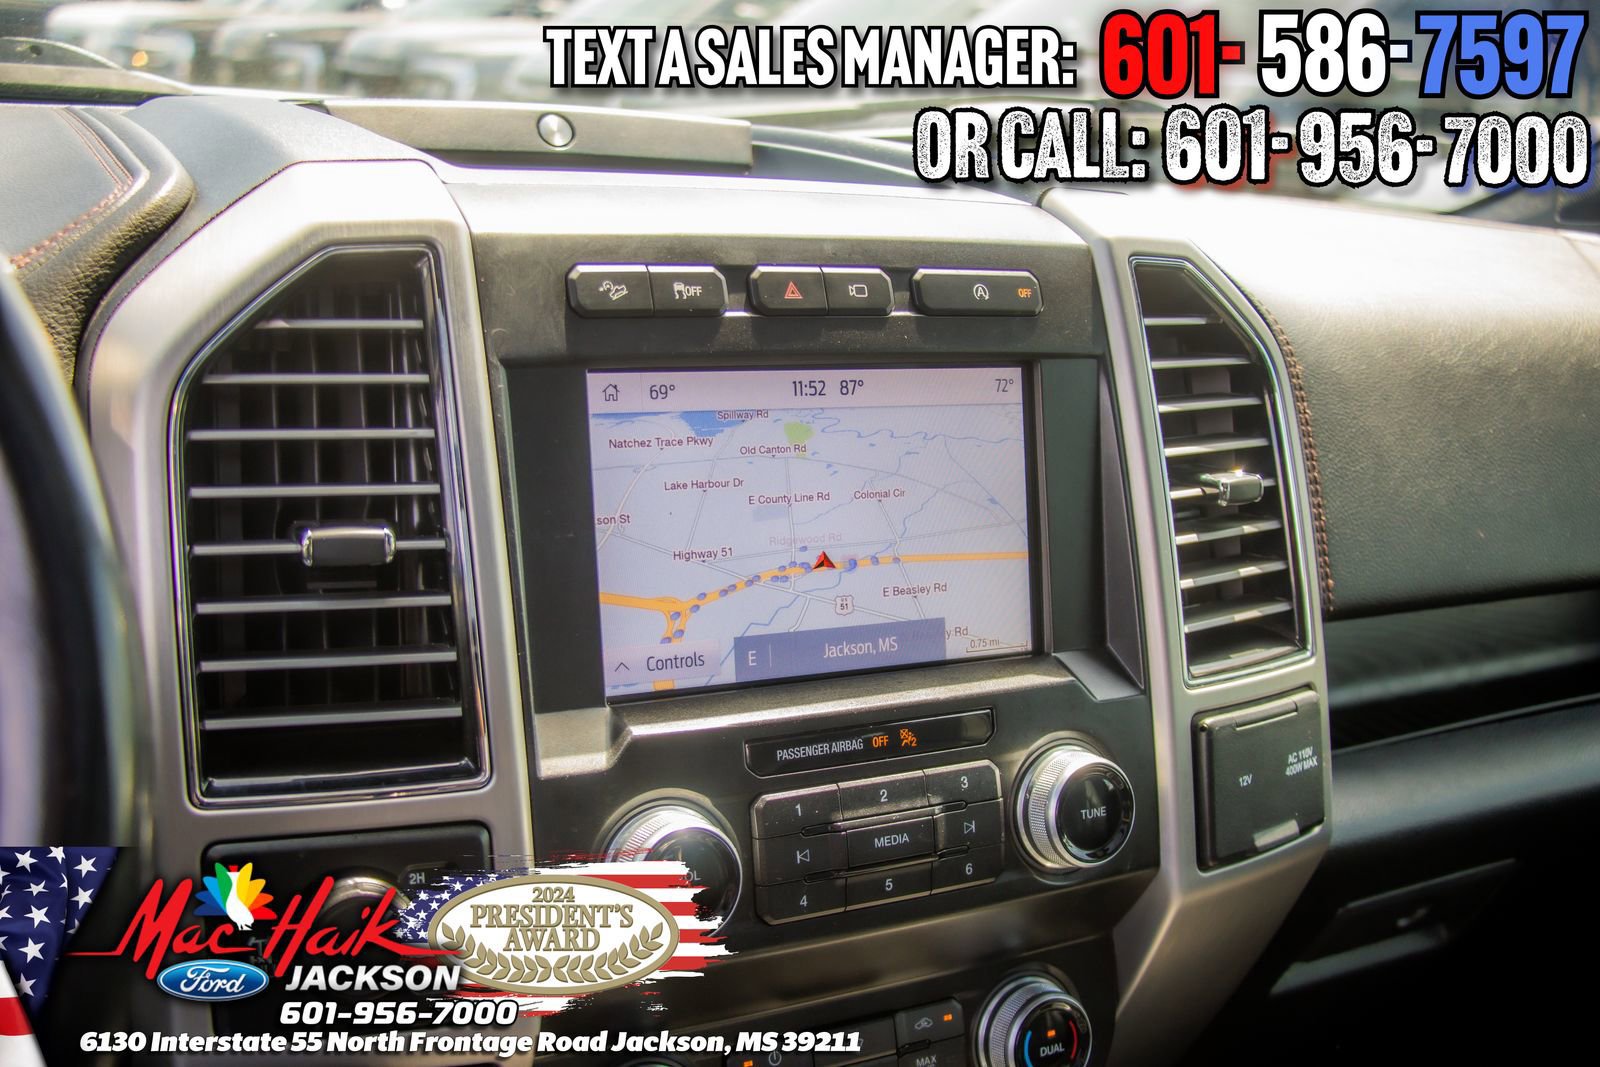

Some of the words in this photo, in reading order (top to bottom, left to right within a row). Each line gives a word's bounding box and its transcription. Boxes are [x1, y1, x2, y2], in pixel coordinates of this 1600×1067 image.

[684, 285, 702, 297] OFF
[1017, 288, 1032, 298] OFF
[649, 384, 676, 400] 69°
[792, 380, 826, 396] 11:52
[839, 379, 864, 396] 87°
[995, 378, 1014, 393] 72°
[717, 410, 755, 421] Spillway
[757, 409, 769, 418] Rd
[608, 438, 652, 449] Natchez
[654, 437, 684, 447] Trace
[686, 436, 714, 447] Pkwy
[740, 445, 756, 455] Old
[758, 445, 791, 454] Canton
[794, 444, 807, 453] Rd
[664, 481, 688, 491] Lake
[690, 479, 730, 490] Harbour
[733, 477, 745, 488] Dr
[748, 495, 755, 505] E
[757, 494, 792, 506] County
[794, 492, 815, 502] Line
[816, 491, 830, 501] Rd
[853, 488, 891, 500] Colonial
[893, 488, 906, 498] Cir
[619, 513, 631, 524] St
[673, 549, 719, 562] Highway
[721, 547, 733, 557] 51
[882, 587, 889, 597] E
[892, 584, 931, 596] Beasley
[933, 582, 947, 593] Rd
[840, 602, 848, 611] 51
[954, 626, 969, 637] Rd
[823, 641, 877, 658] Jackson,
[879, 636, 898, 652] MS
[970, 639, 988, 649] 0.75
[989, 639, 1000, 648] mi
[646, 652, 705, 672] Controls
[748, 650, 757, 666] E
[776, 742, 831, 761] PASSENGER
[831, 738, 864, 754] AIRBAG
[872, 735, 889, 748] OFF
[1287, 751, 1298, 764] AC
[1299, 746, 1314, 760] 110V
[1285, 762, 1303, 776] 400W
[1303, 756, 1318, 769] MAX
[960, 776, 969, 789] 3
[1238, 773, 1253, 787] 12V
[879, 789, 888, 802] 2
[795, 804, 802, 817] 1
[1080, 805, 1107, 820] TUNE
[874, 833, 910, 849] MEDIA
[965, 862, 973, 875] 6
[408, 872, 426, 884] 2H
[885, 878, 893, 891] 5
[800, 894, 808, 907] 4
[1039, 1042, 1065, 1057] DUAL
[916, 1054, 937, 1067] MAX
